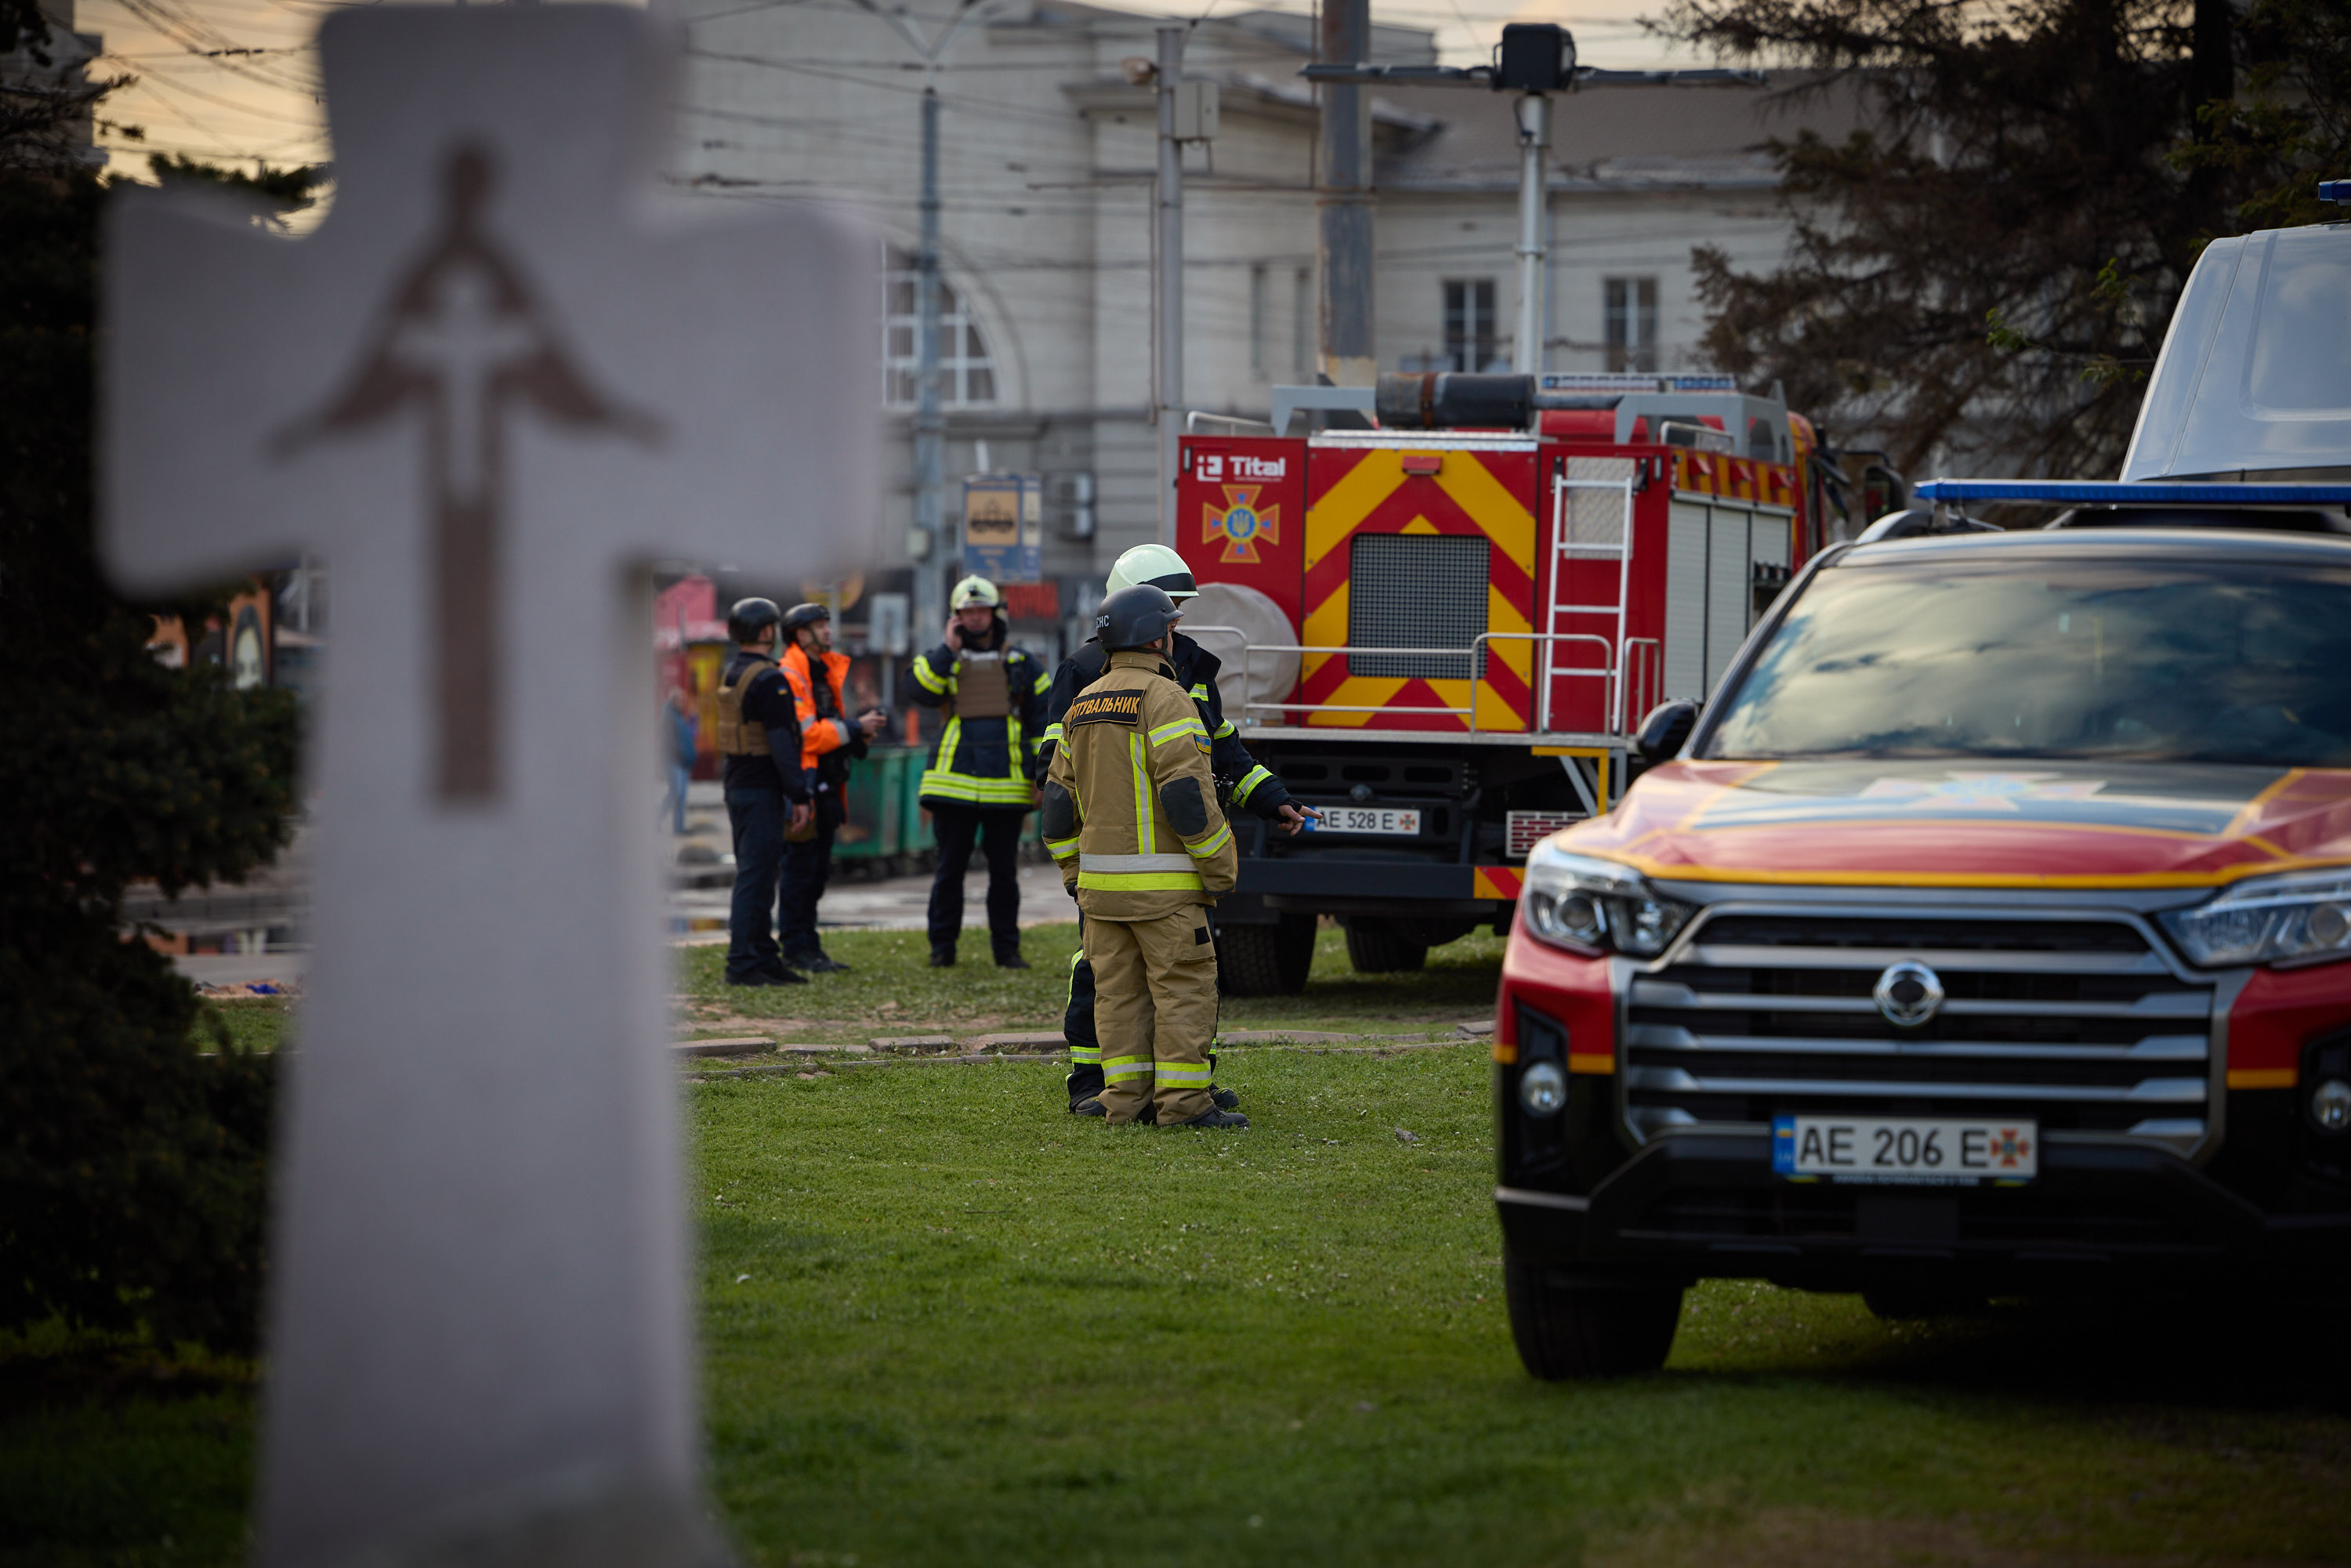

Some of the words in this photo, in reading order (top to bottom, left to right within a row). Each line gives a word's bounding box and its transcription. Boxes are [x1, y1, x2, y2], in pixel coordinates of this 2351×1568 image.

[1229, 455, 1285, 477] Tital
[1347, 812, 1376, 829] 528
[1382, 813, 1394, 830] E
[1800, 1126, 1856, 1166] AE
[1873, 1128, 1943, 1167] 206
[1962, 1129, 1989, 1168] E
